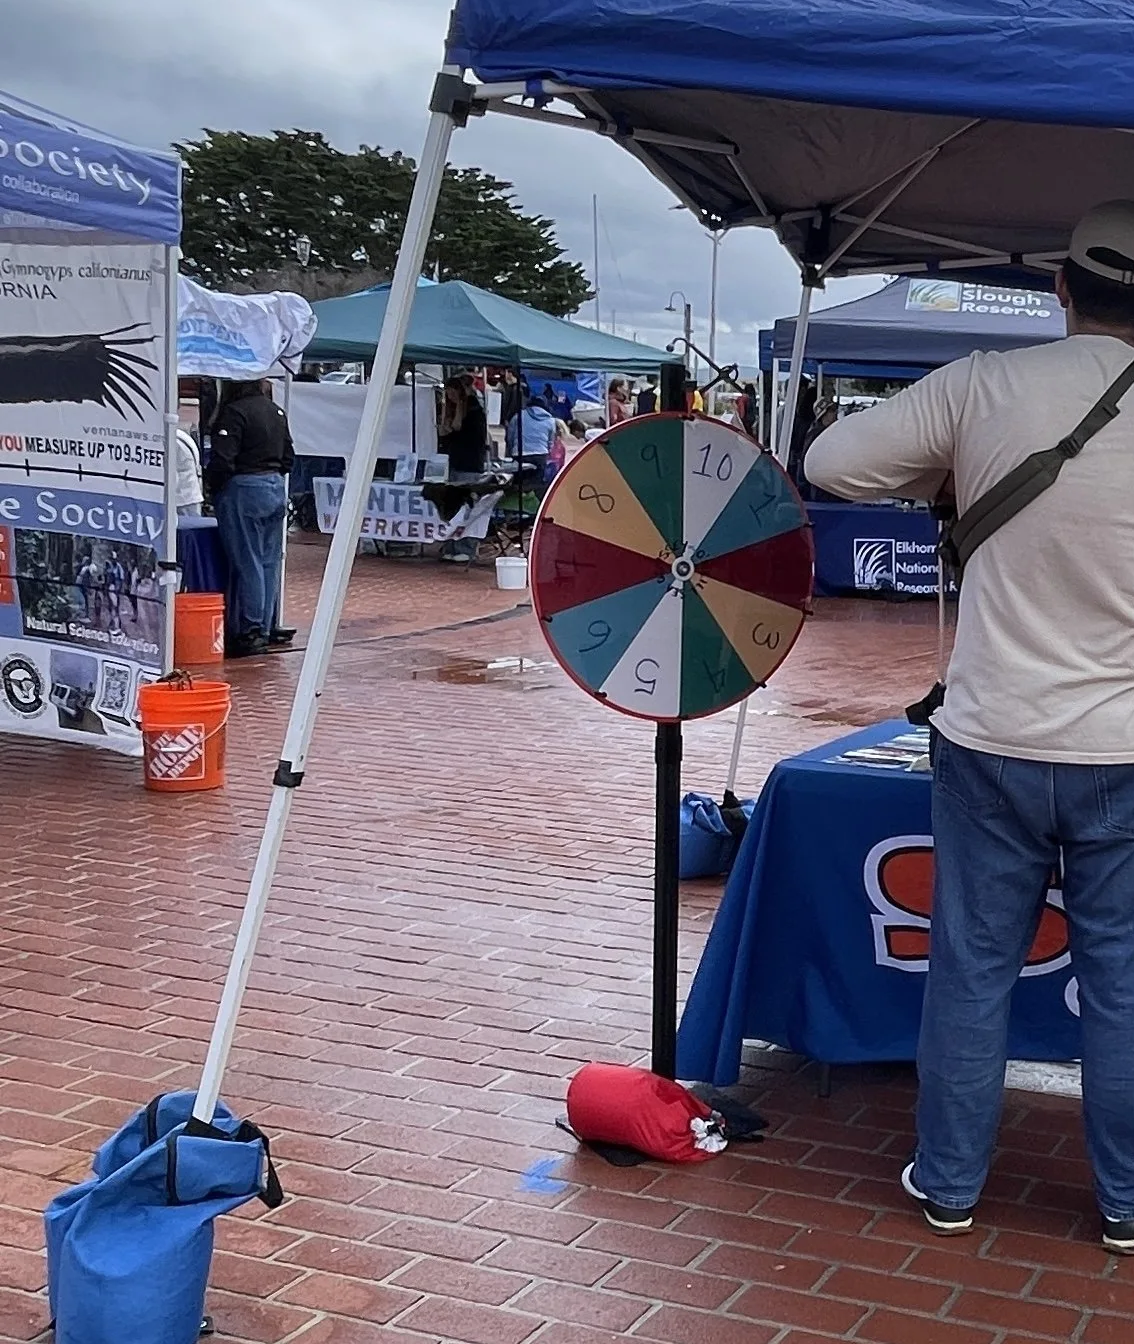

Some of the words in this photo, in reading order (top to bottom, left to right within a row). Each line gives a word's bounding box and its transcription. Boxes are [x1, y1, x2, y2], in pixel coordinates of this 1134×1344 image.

[2, 174, 80, 204] collaboration
[961, 289, 1041, 306] Slough
[961, 302, 1051, 318] Reserve
[82, 425, 165, 443] ventanaws.or
[25, 436, 86, 456] MEASURE
[87, 442, 105, 459] UP
[108, 444, 122, 461] TO
[124, 444, 143, 463] 9.5
[640, 444, 663, 479] 9
[692, 443, 733, 482] 10
[578, 484, 615, 514] 8
[36, 490, 165, 541] Society
[896, 562, 940, 574] Nationa
[26, 614, 67, 635] Natural
[752, 622, 780, 651] 3
[634, 658, 660, 696] 5
